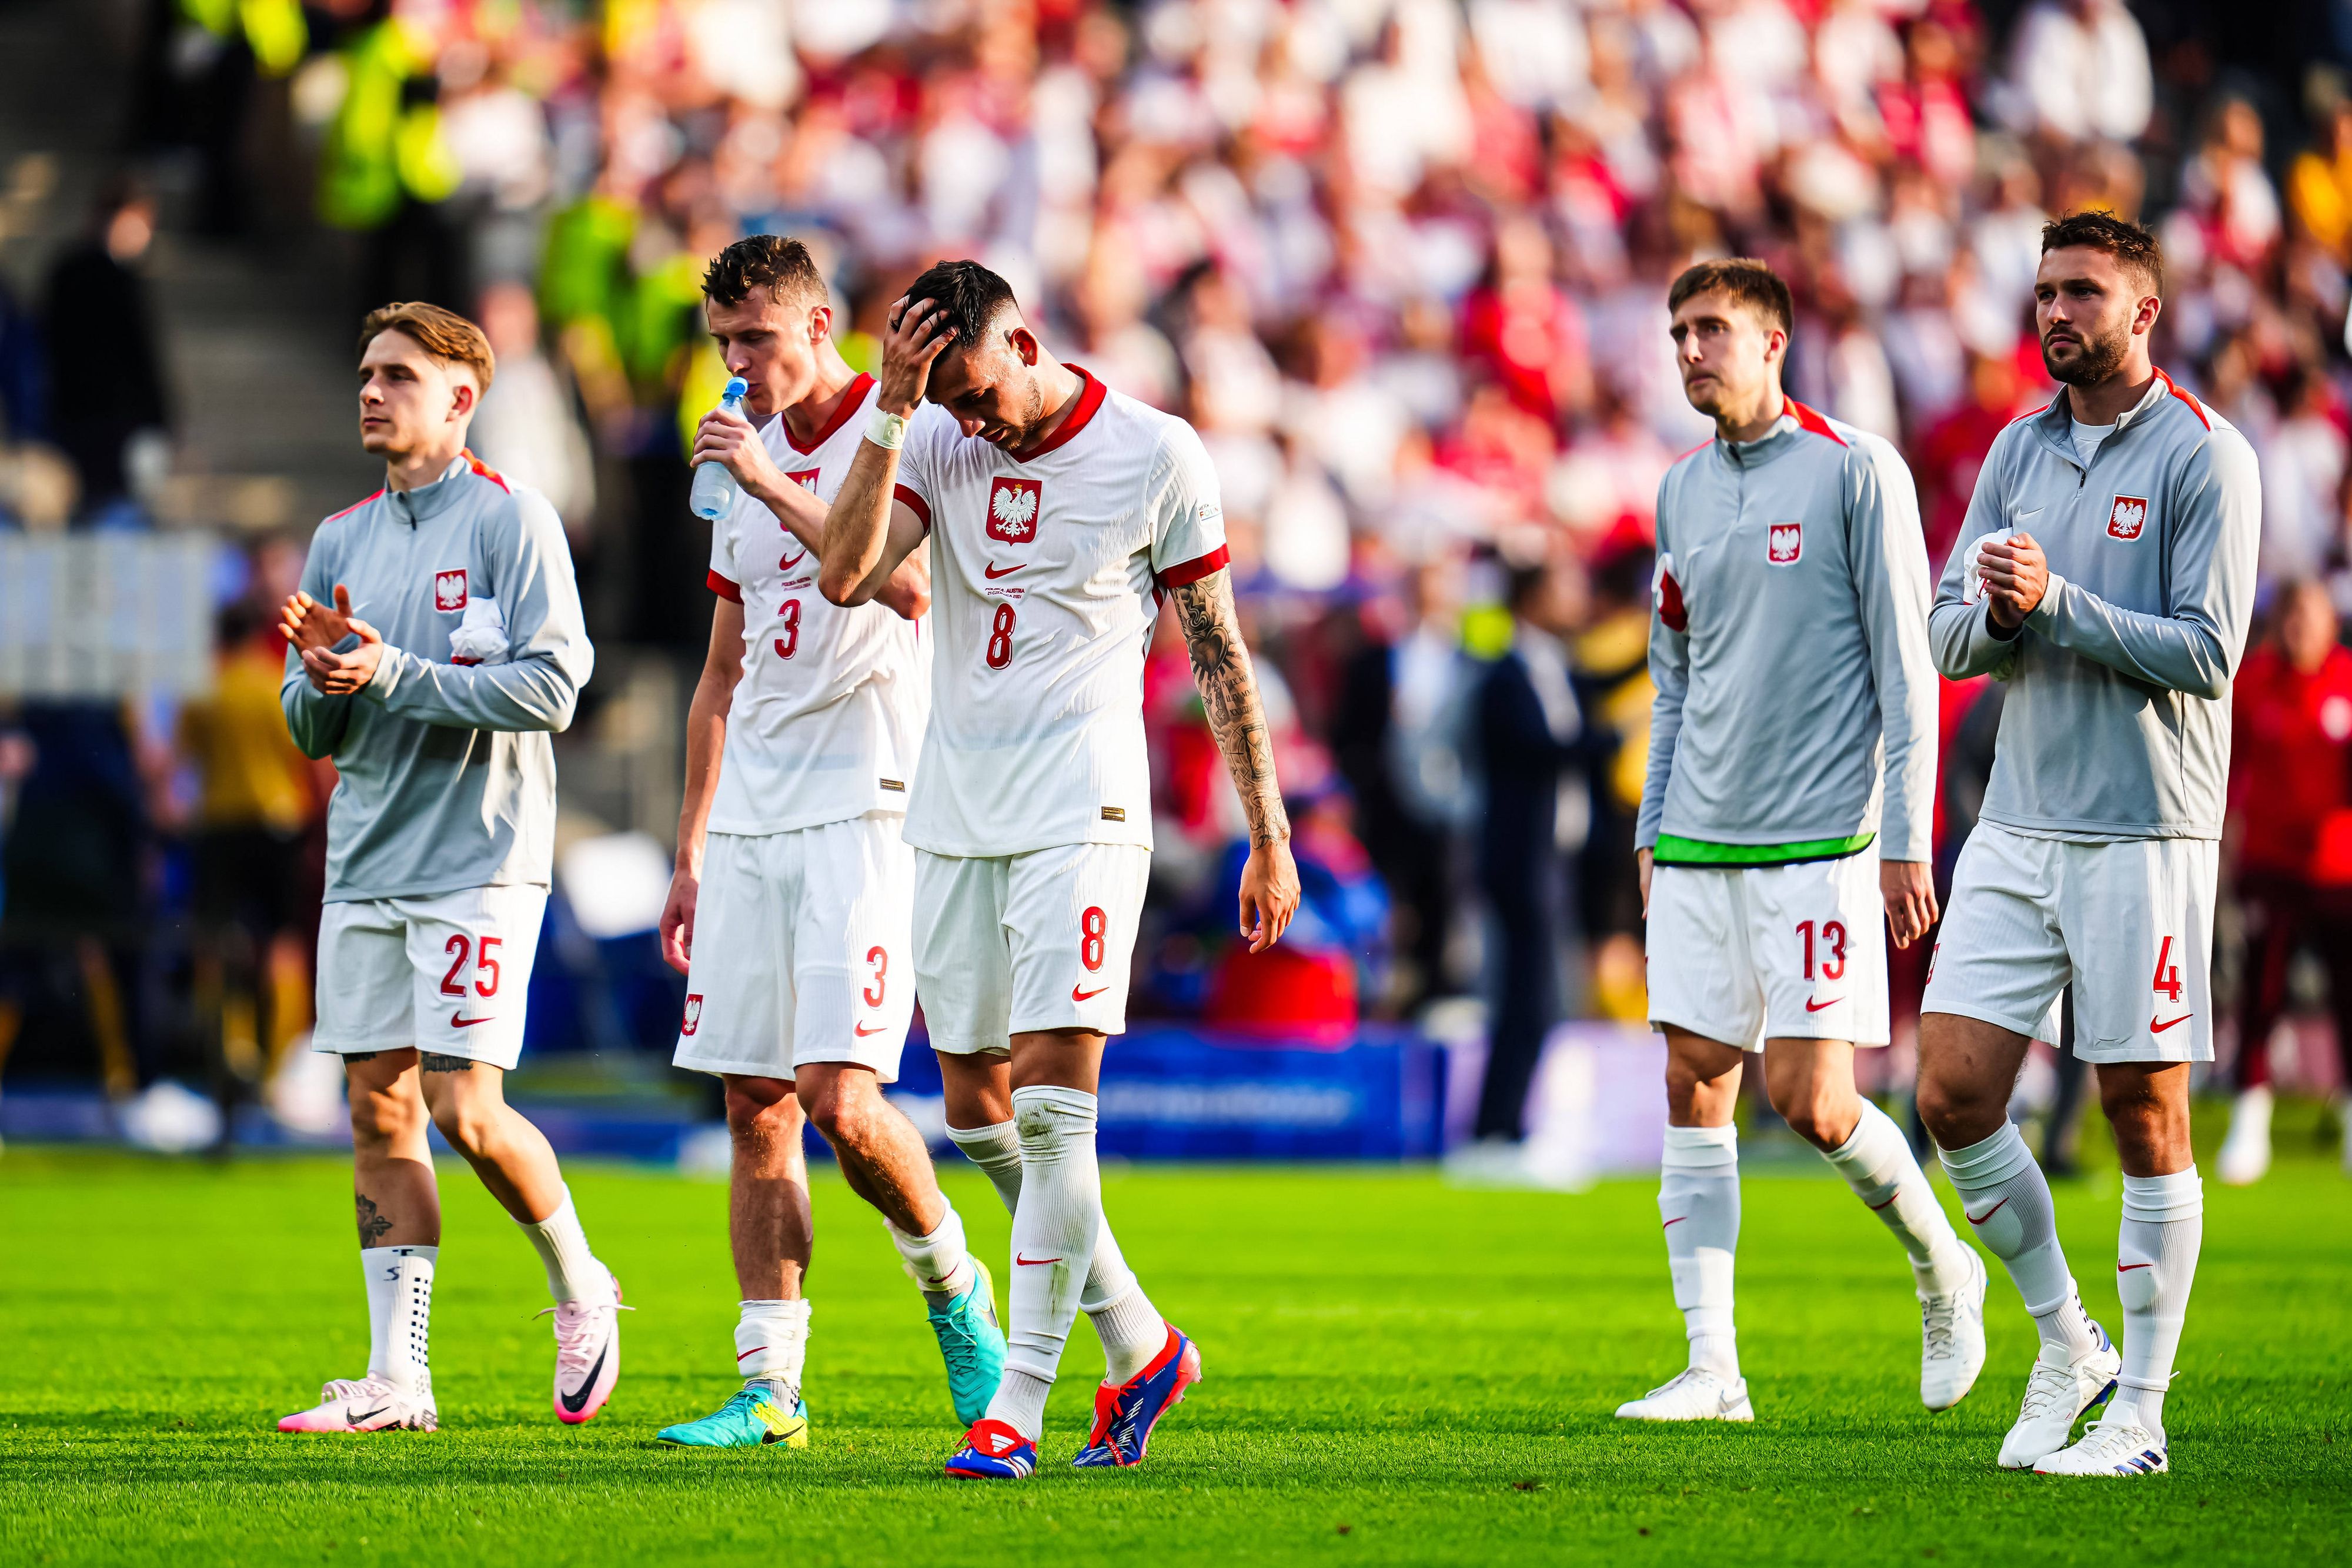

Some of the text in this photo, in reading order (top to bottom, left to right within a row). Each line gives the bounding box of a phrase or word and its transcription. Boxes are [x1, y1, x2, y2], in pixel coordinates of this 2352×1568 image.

[774, 599, 801, 660] 3
[985, 602, 1017, 670] 8
[440, 934, 503, 999] 25
[1081, 906, 1108, 974] 8
[1796, 920, 1847, 982] 13
[2153, 935, 2183, 1002] 4
[863, 945, 888, 1011] 3
